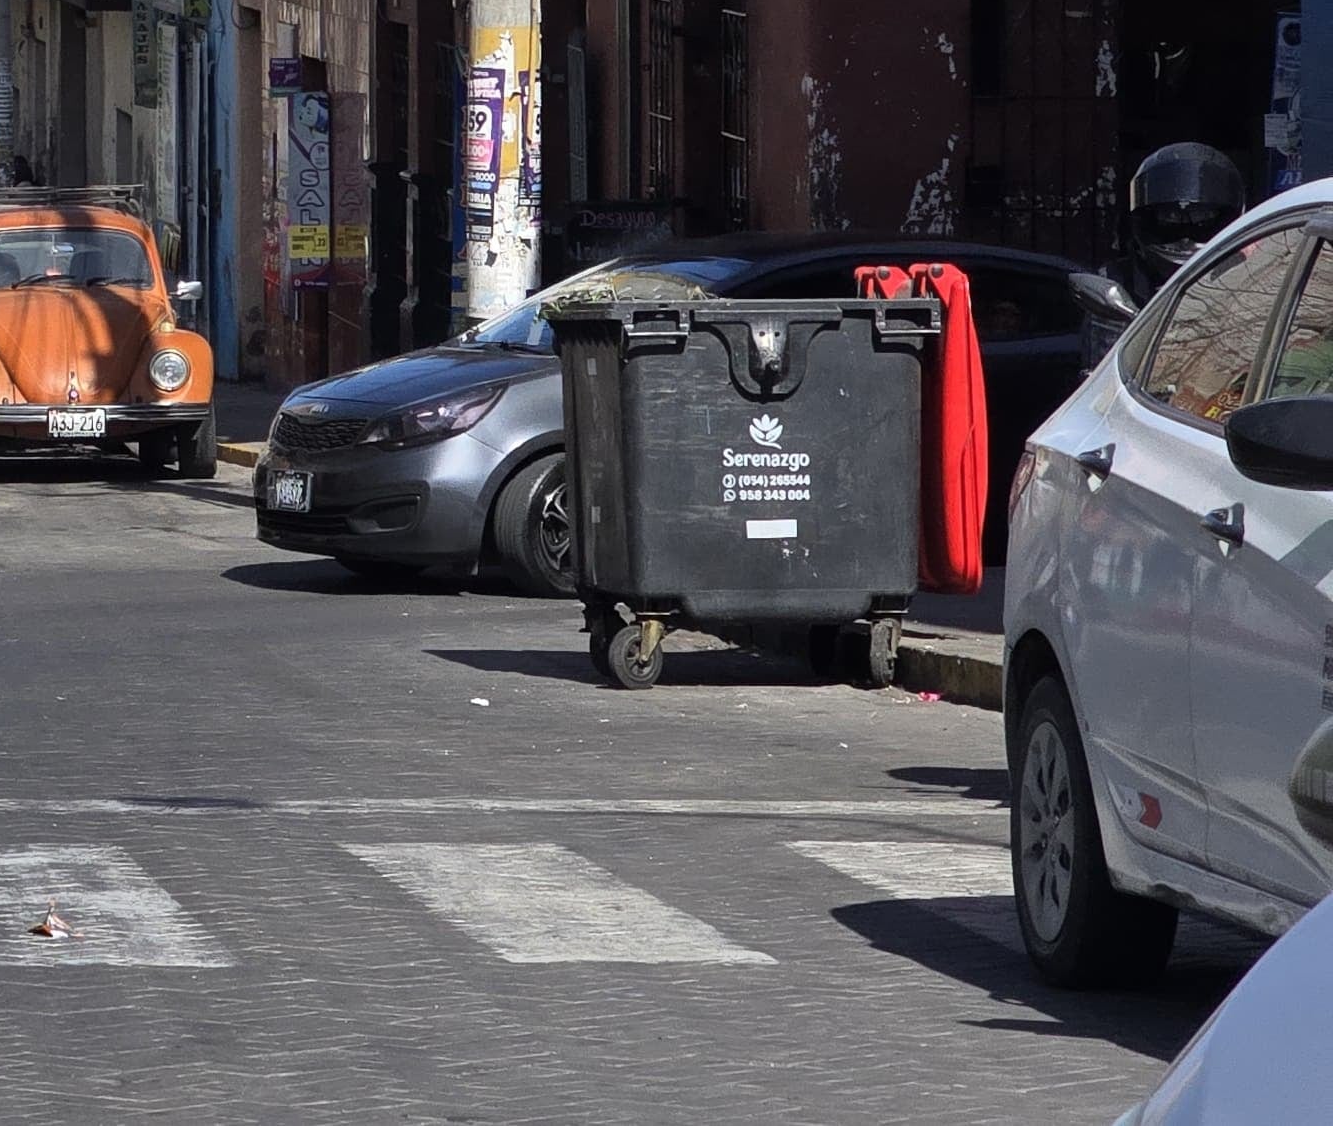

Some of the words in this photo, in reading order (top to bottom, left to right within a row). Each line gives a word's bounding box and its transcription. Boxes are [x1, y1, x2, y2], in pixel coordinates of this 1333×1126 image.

[50, 415, 103, 432] A3J-216
[722, 448, 810, 472] Serenazgo
[738, 475, 768, 487] (054)
[770, 475, 810, 486] 265544
[738, 490, 761, 500] 958
[764, 490, 786, 500] 343
[787, 490, 810, 500] 004
